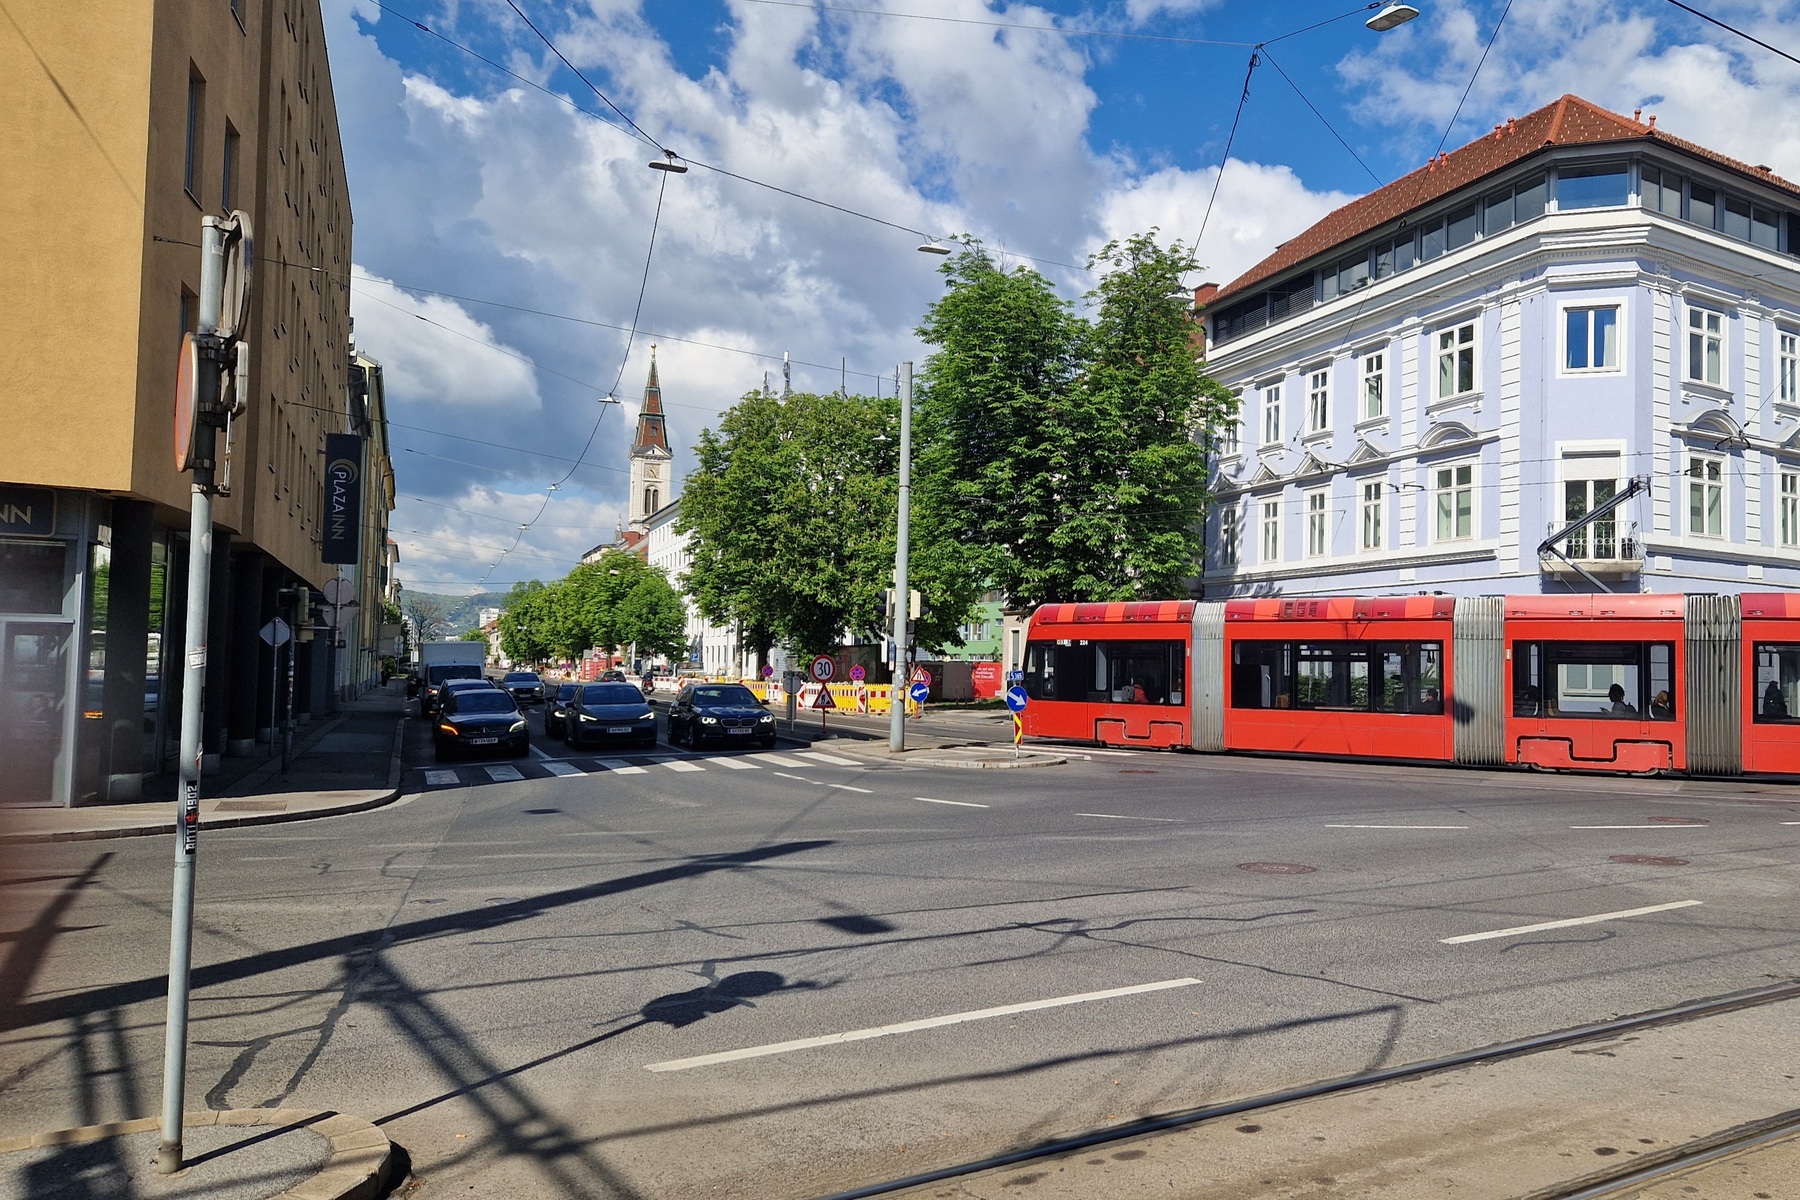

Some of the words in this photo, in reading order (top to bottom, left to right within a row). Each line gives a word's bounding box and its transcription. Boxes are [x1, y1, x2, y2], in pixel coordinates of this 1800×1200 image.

[332, 472, 346, 513] PLAZA
[331, 514, 345, 540] INN
[817, 661, 831, 677] 30
[187, 785, 198, 811] 1902
[185, 825, 197, 850] ANTI
